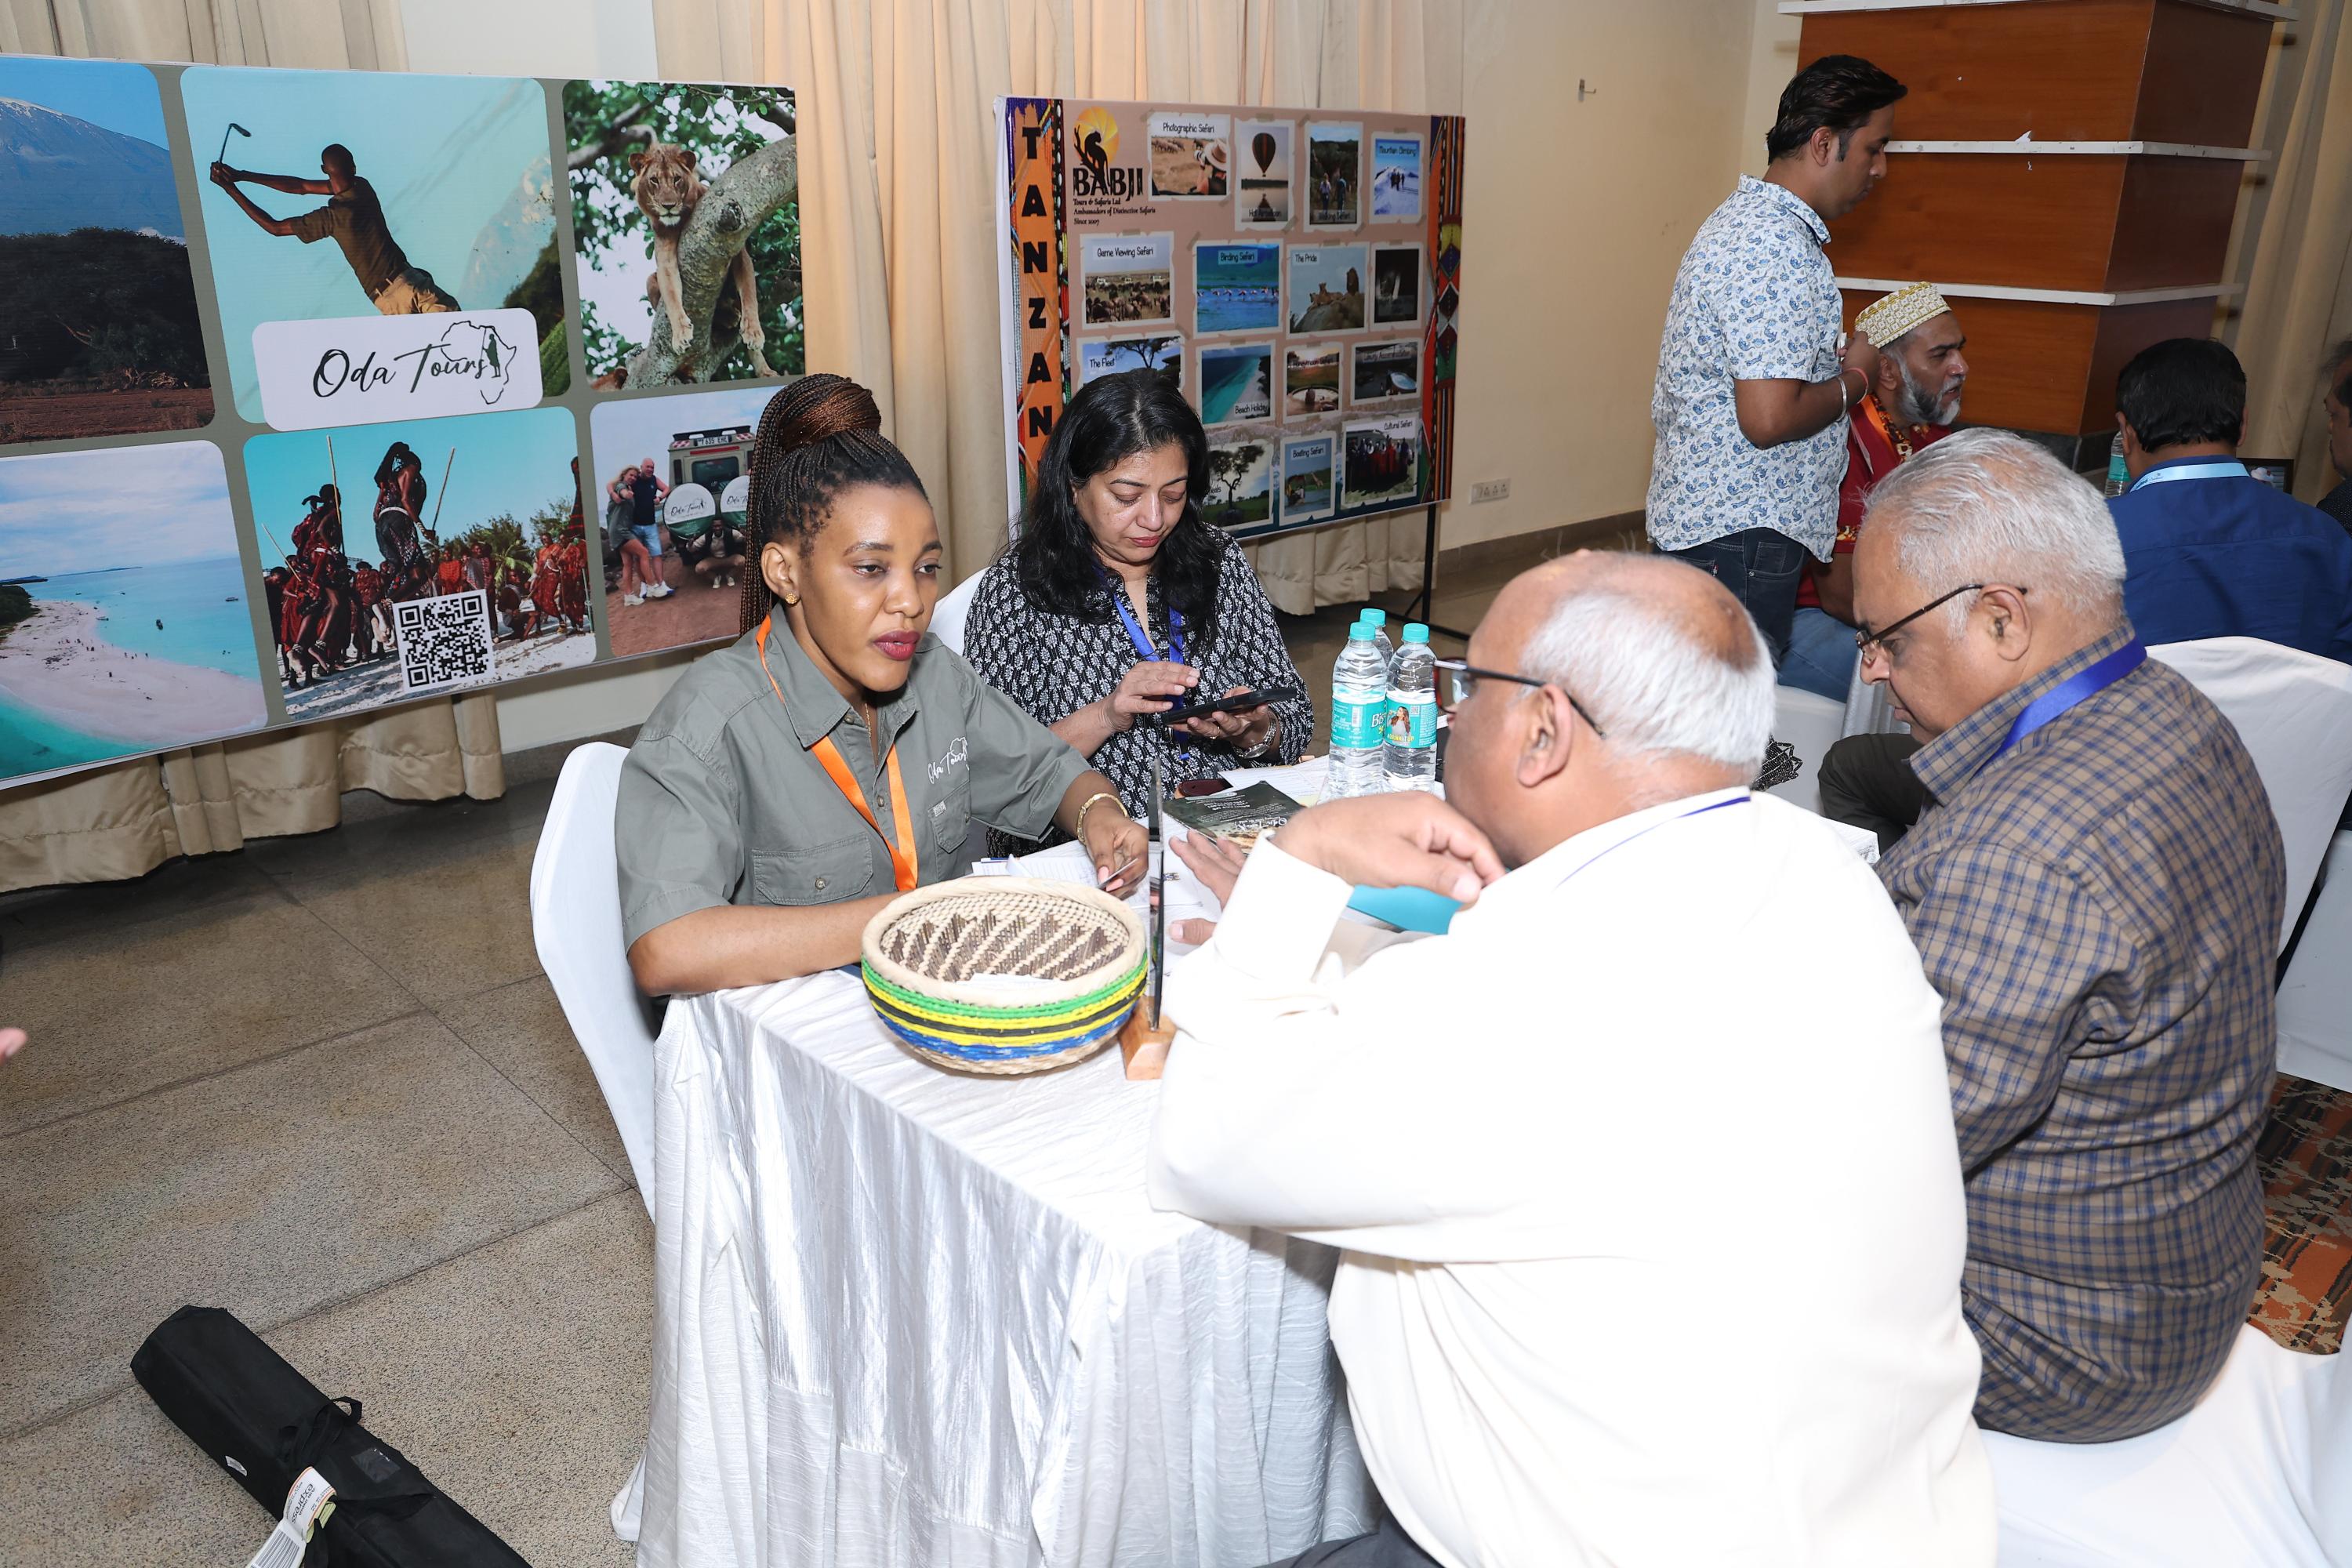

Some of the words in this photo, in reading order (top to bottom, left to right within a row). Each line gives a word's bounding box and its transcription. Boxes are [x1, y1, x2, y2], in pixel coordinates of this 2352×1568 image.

[1163, 122, 1197, 134] Photographic
[1198, 123, 1214, 133] Safari
[1073, 168, 1143, 201] BABJI
[1094, 198, 1111, 206] Safaris
[1107, 207, 1112, 216] of
[1139, 205, 1156, 215] Safaris
[1098, 248, 1113, 257] Game
[1114, 247, 1135, 258] Viewing
[1136, 246, 1153, 256] Safari
[1220, 252, 1238, 262] Birding
[1240, 251, 1254, 260] Safari
[1295, 254, 1304, 263] The
[1305, 253, 1317, 262] Pride
[1022, 127, 1052, 437] TANZAN
[1090, 358, 1101, 368] The
[1102, 357, 1116, 368] Fleet
[313, 348, 396, 397] Oda
[394, 343, 488, 393] Tours
[1235, 405, 1250, 414] Beach
[1250, 403, 1268, 412] Holiday
[1371, 713, 1386, 728] Bis
[292, 1483, 314, 1523] express
